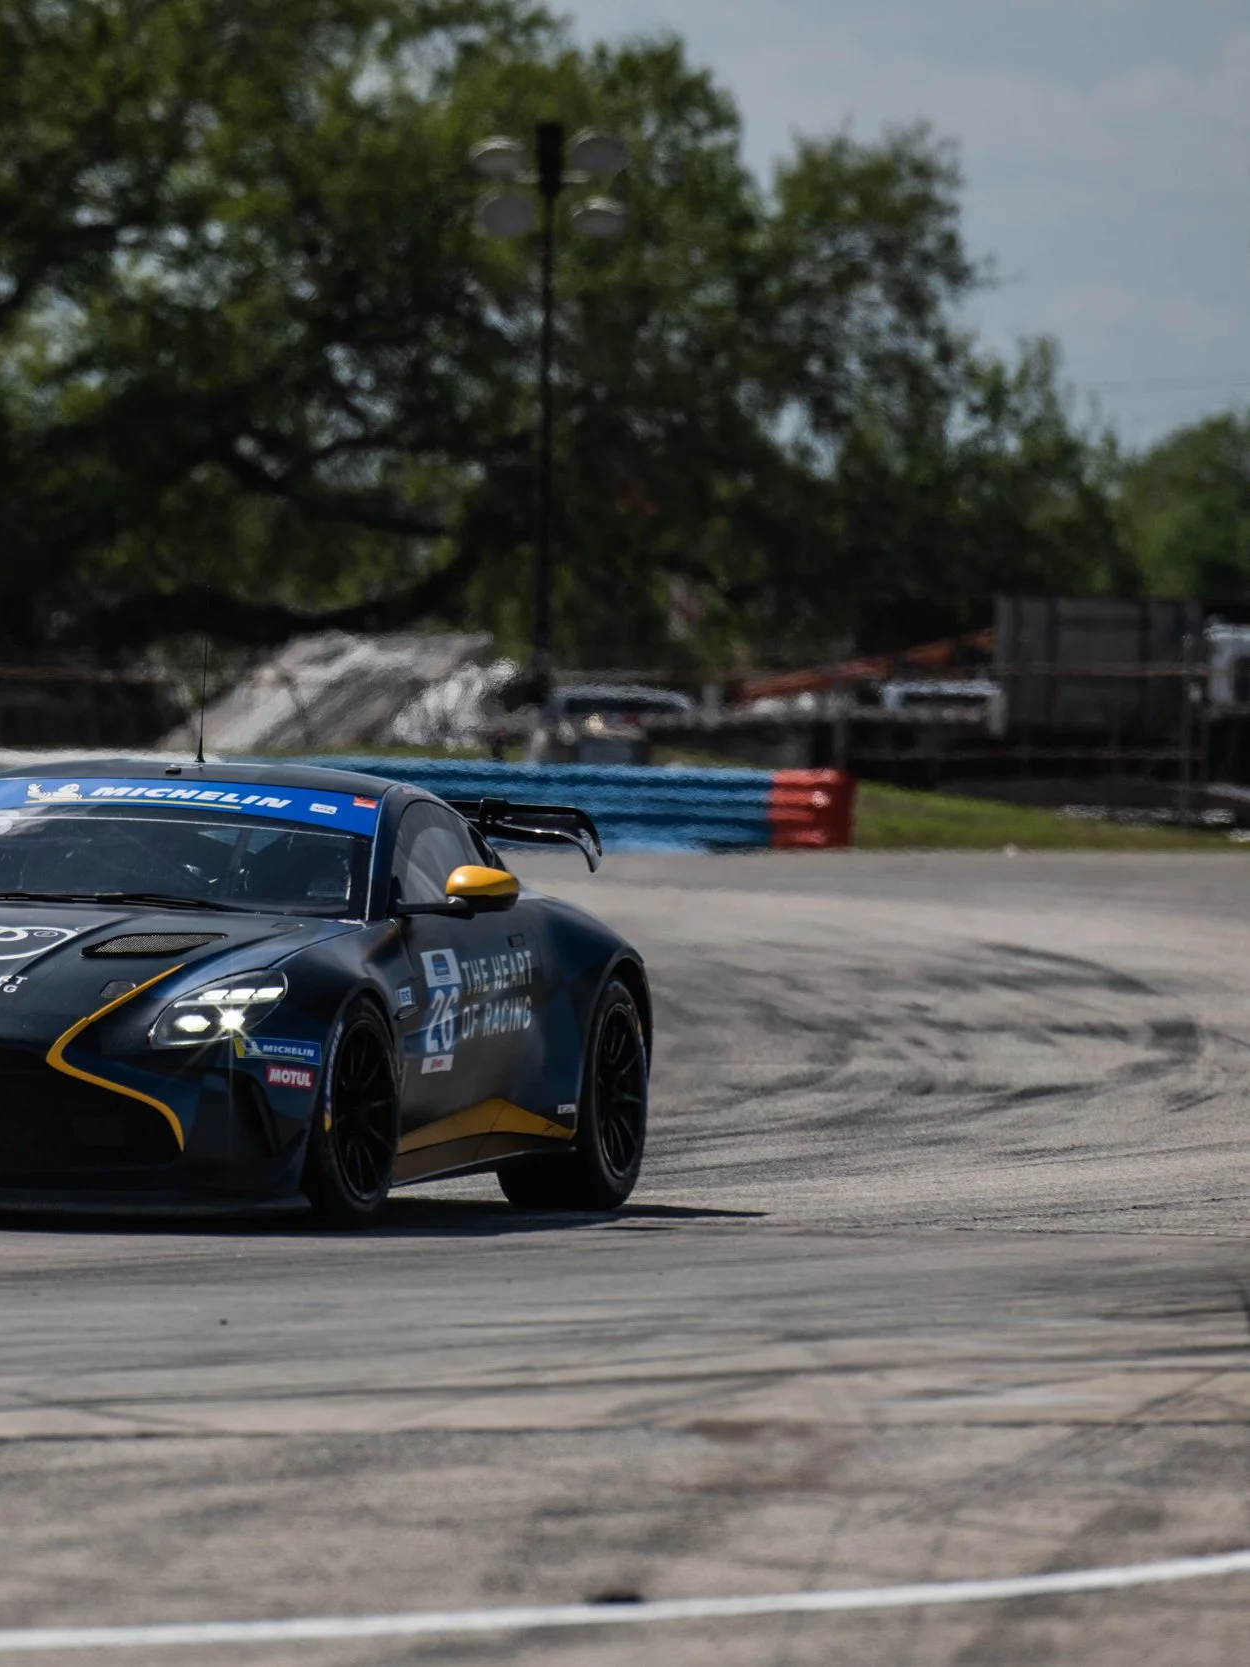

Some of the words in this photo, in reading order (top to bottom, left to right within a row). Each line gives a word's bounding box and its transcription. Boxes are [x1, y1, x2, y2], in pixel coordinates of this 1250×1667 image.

[91, 786, 292, 809] MICHELIN
[462, 958, 490, 995] THE
[491, 950, 533, 991] HEART
[425, 986, 459, 1052] 26
[461, 1003, 481, 1040] OF
[482, 995, 533, 1037] RACING
[263, 1044, 315, 1058] MICHELIN
[269, 1069, 312, 1087] MOTUL
